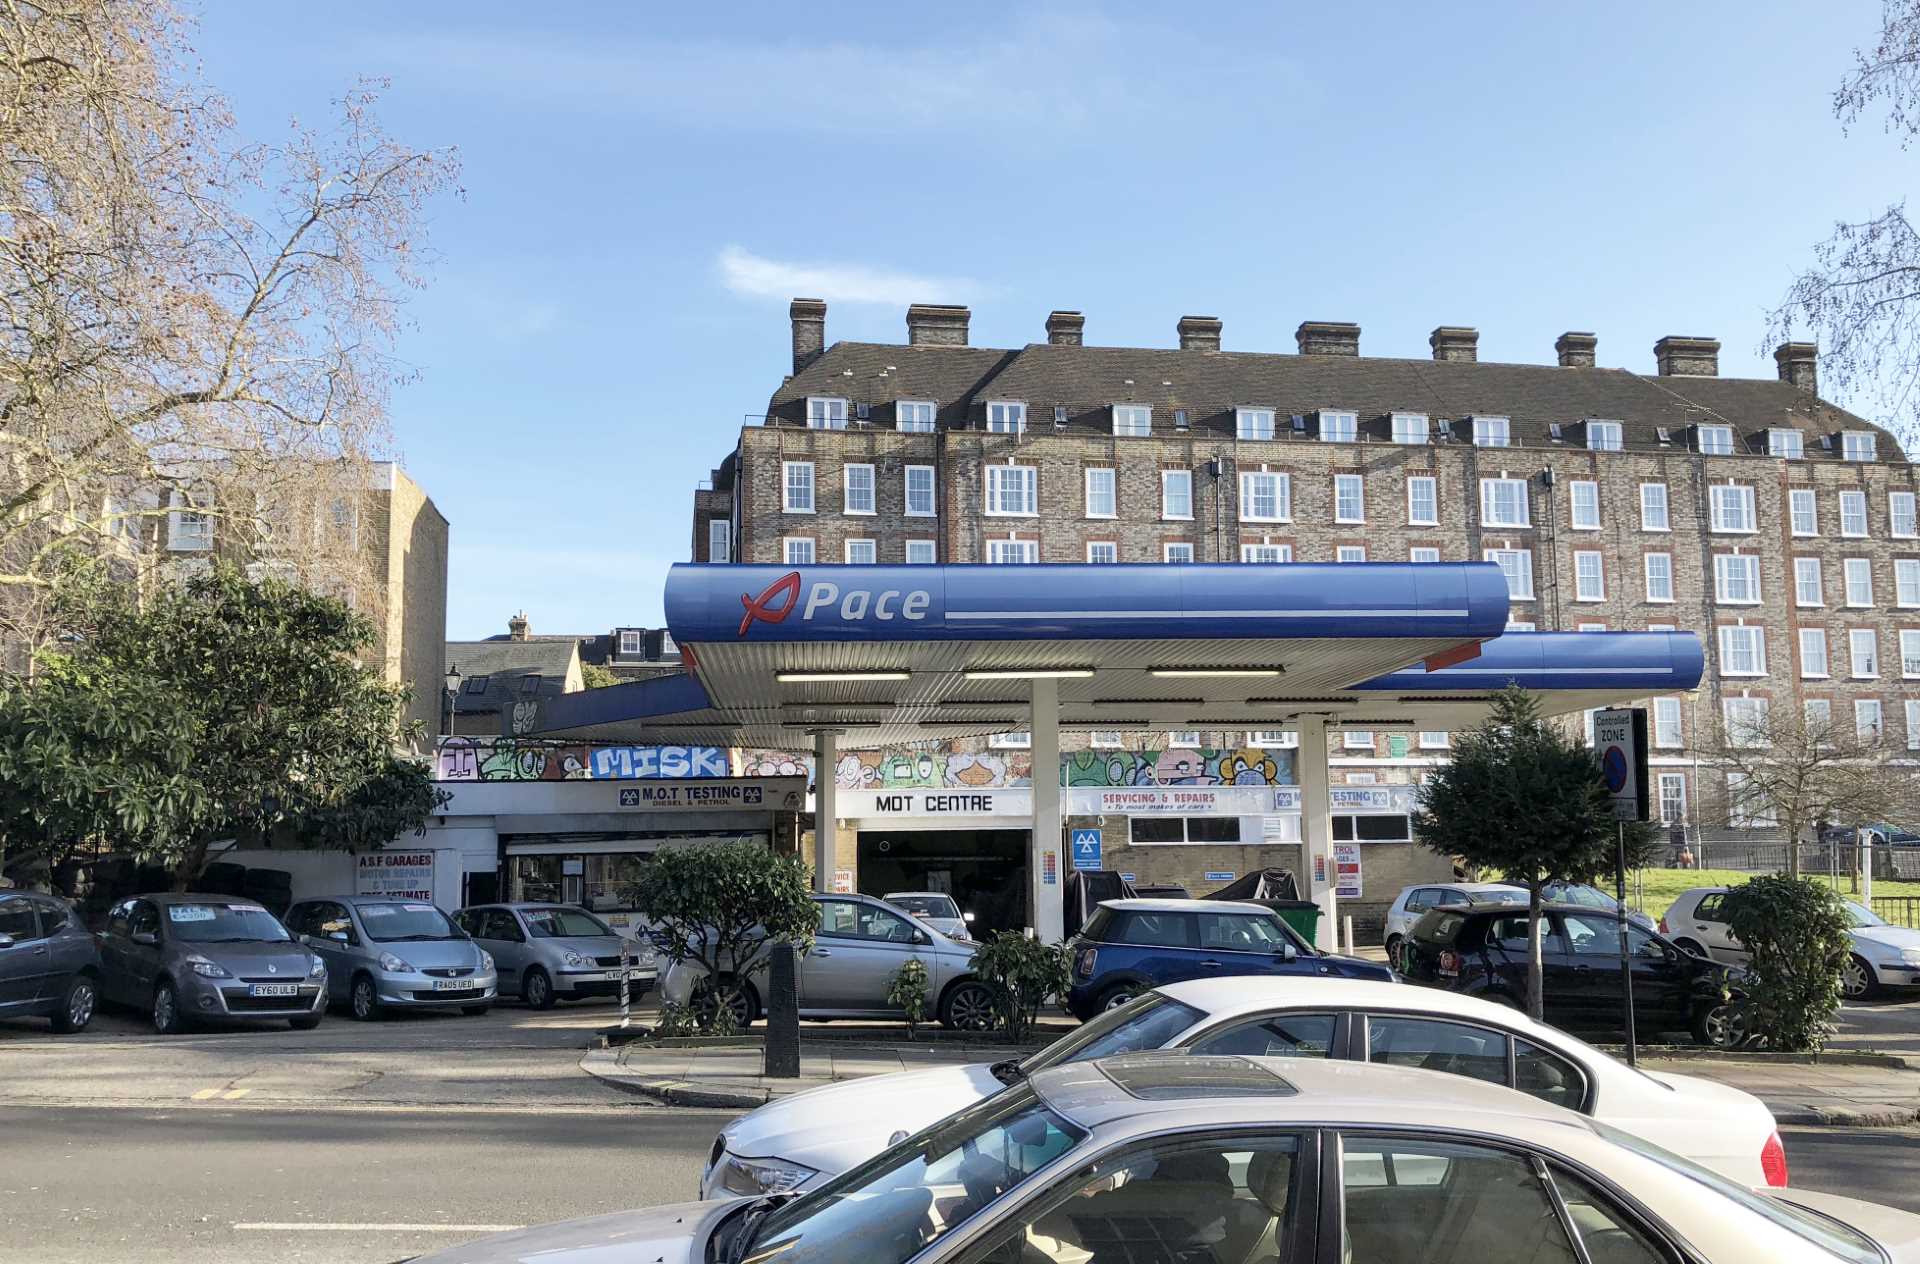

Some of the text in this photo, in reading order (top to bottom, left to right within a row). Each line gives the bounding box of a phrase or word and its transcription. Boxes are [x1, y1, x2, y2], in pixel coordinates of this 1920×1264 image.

[802, 582, 931, 620] Pace
[1596, 714, 1630, 726] Controlled
[1601, 729, 1625, 741] ZONE
[596, 746, 726, 778] MISK
[642, 786, 740, 800] M.O.T TESTING
[1103, 793, 1215, 803] SERVICING & REPAIRS
[876, 795, 993, 811] MOT CENTRE
[385, 855, 432, 866] GARAGES
[393, 868, 432, 878] REPAIRS
[255, 986, 296, 994] EY60 ULB
